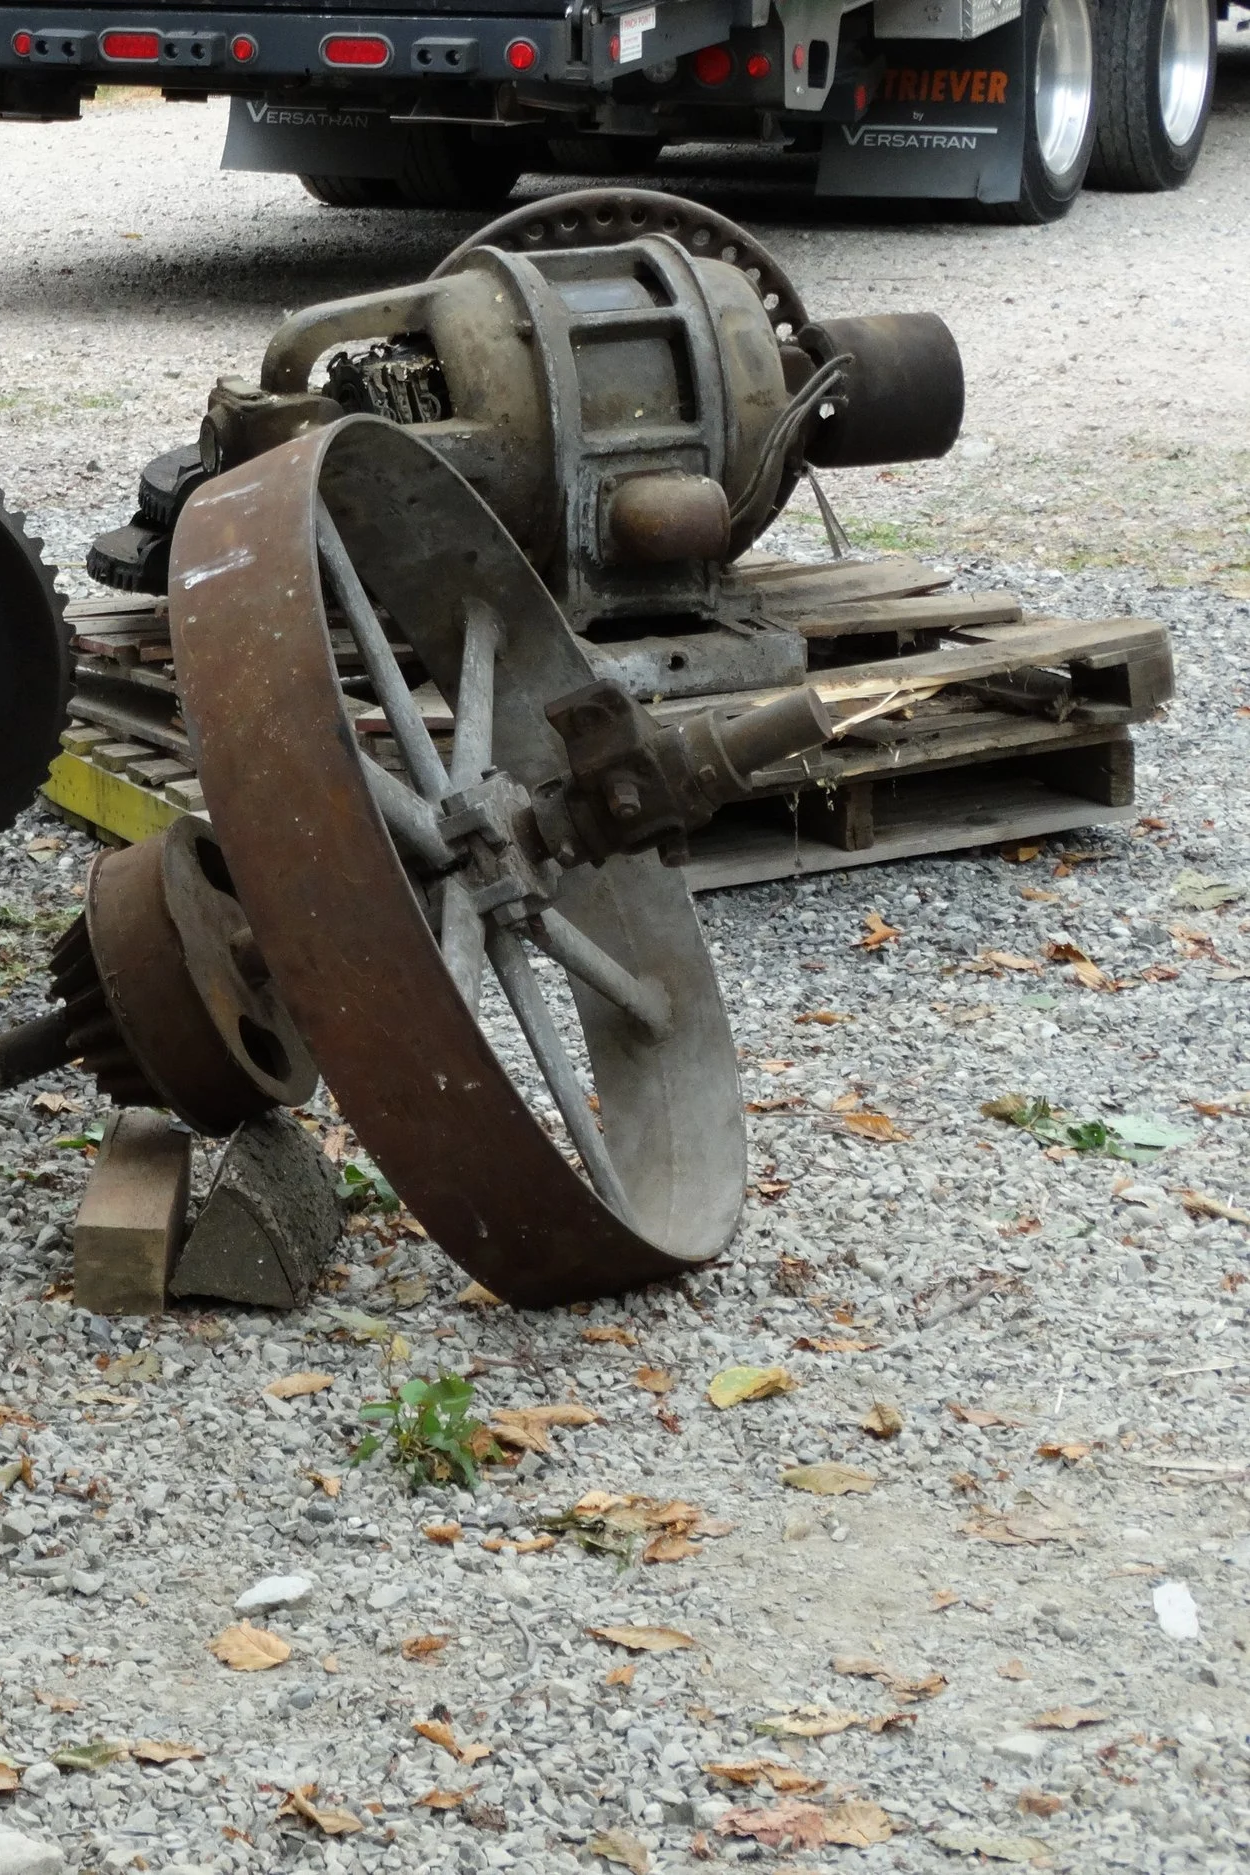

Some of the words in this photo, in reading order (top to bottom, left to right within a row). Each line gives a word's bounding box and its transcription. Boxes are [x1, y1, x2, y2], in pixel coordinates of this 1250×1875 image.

[883, 69, 1009, 104] TRIEVER
[912, 111, 924, 122] by
[841, 124, 977, 150] VERSATRAN
